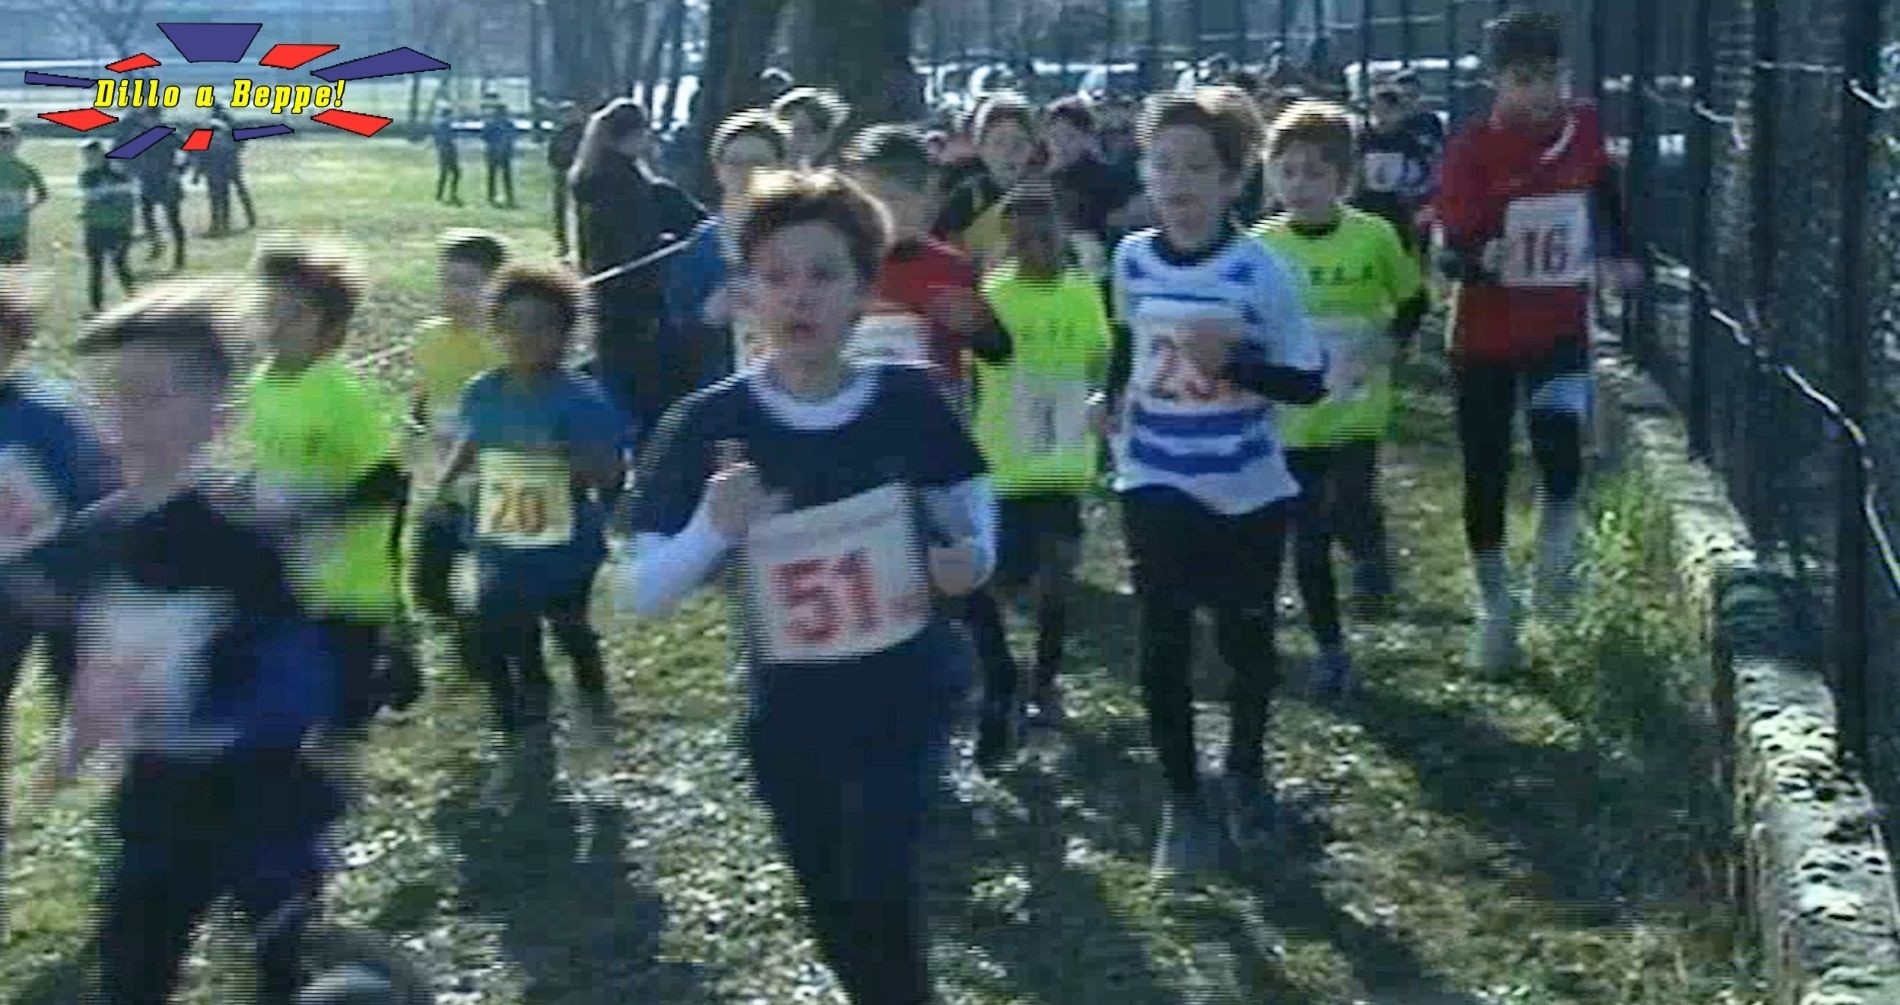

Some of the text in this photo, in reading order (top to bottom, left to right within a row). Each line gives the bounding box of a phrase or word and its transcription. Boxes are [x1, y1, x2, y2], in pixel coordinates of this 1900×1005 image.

[1518, 222, 1571, 274] 16
[489, 481, 547, 534] 20
[767, 546, 880, 643] 51
